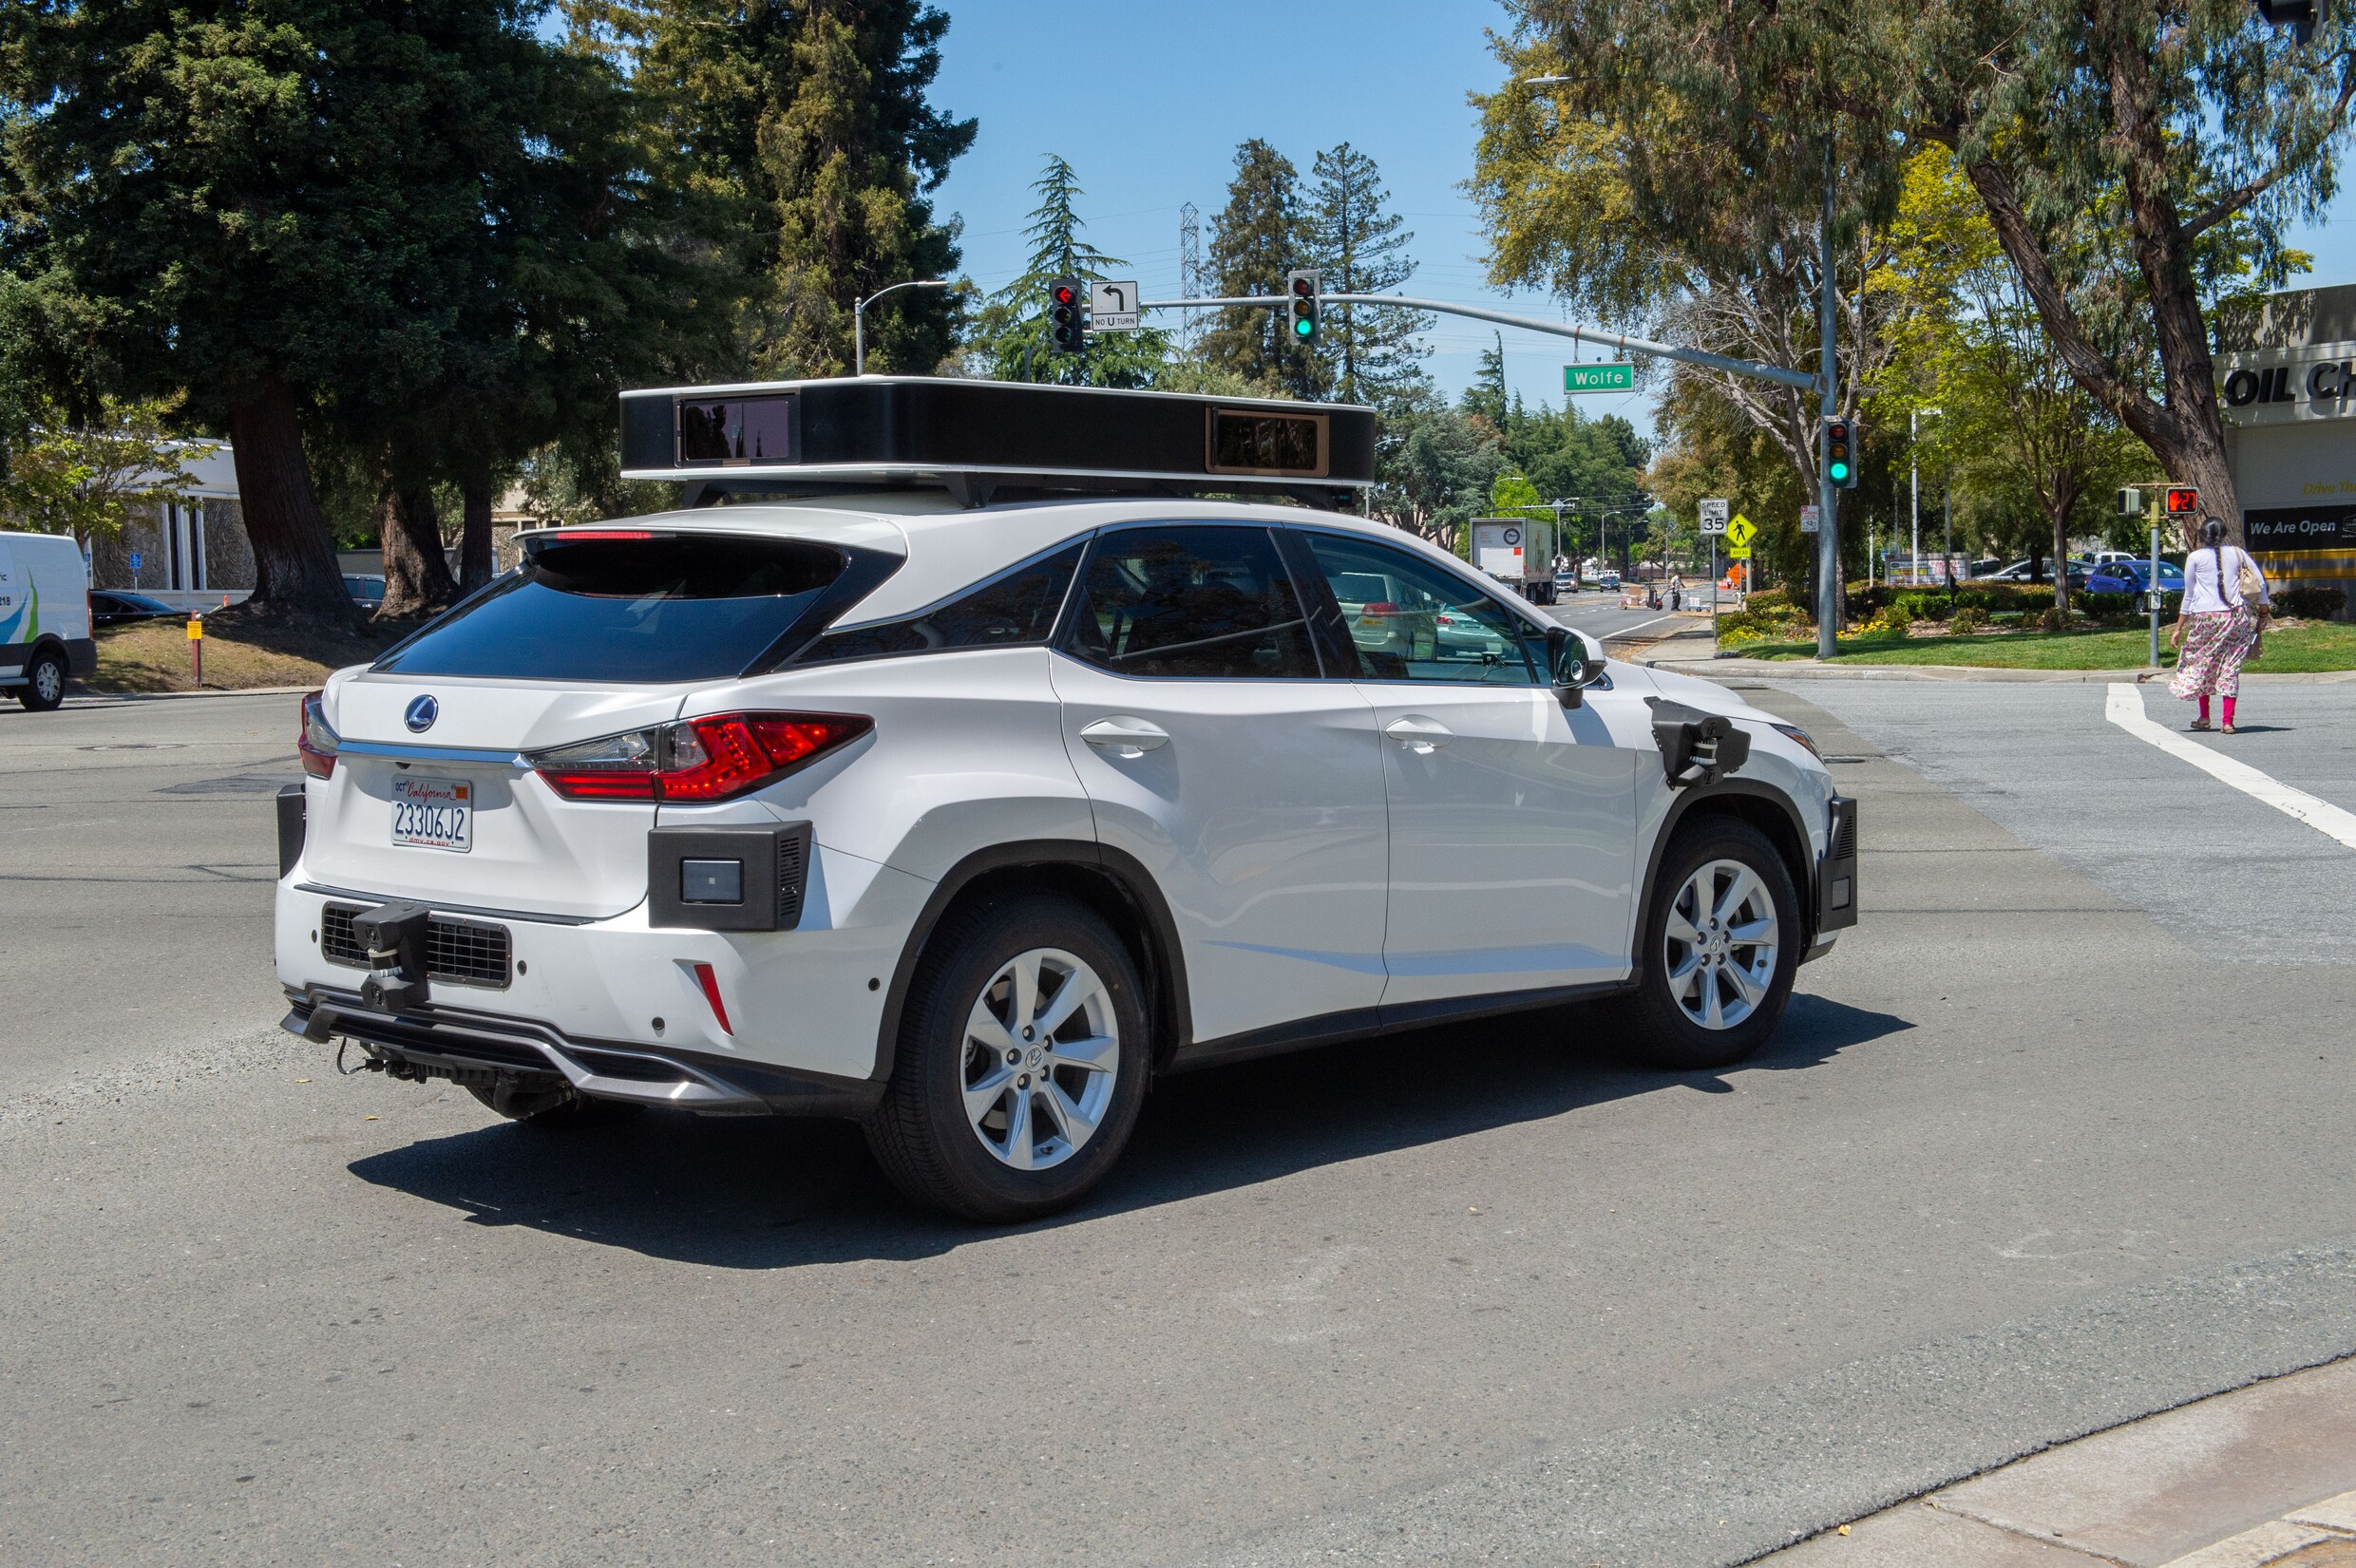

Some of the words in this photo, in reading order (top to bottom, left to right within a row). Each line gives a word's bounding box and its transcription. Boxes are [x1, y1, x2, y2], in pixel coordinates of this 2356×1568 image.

[1107, 317, 1115, 327] U
[1116, 317, 1135, 326] TURN
[1574, 370, 1624, 386] Wolfe
[2224, 368, 2296, 407] OIL
[2181, 492, 2196, 510] 27
[1703, 518, 1724, 531] 35
[2250, 521, 2271, 535] We
[2272, 521, 2297, 534] Are
[2299, 520, 2336, 536] Open
[395, 782, 407, 792] OCT
[407, 781, 457, 803] California
[394, 803, 466, 841] 23306J2
[408, 837, 450, 847] dmv.ca.gov
